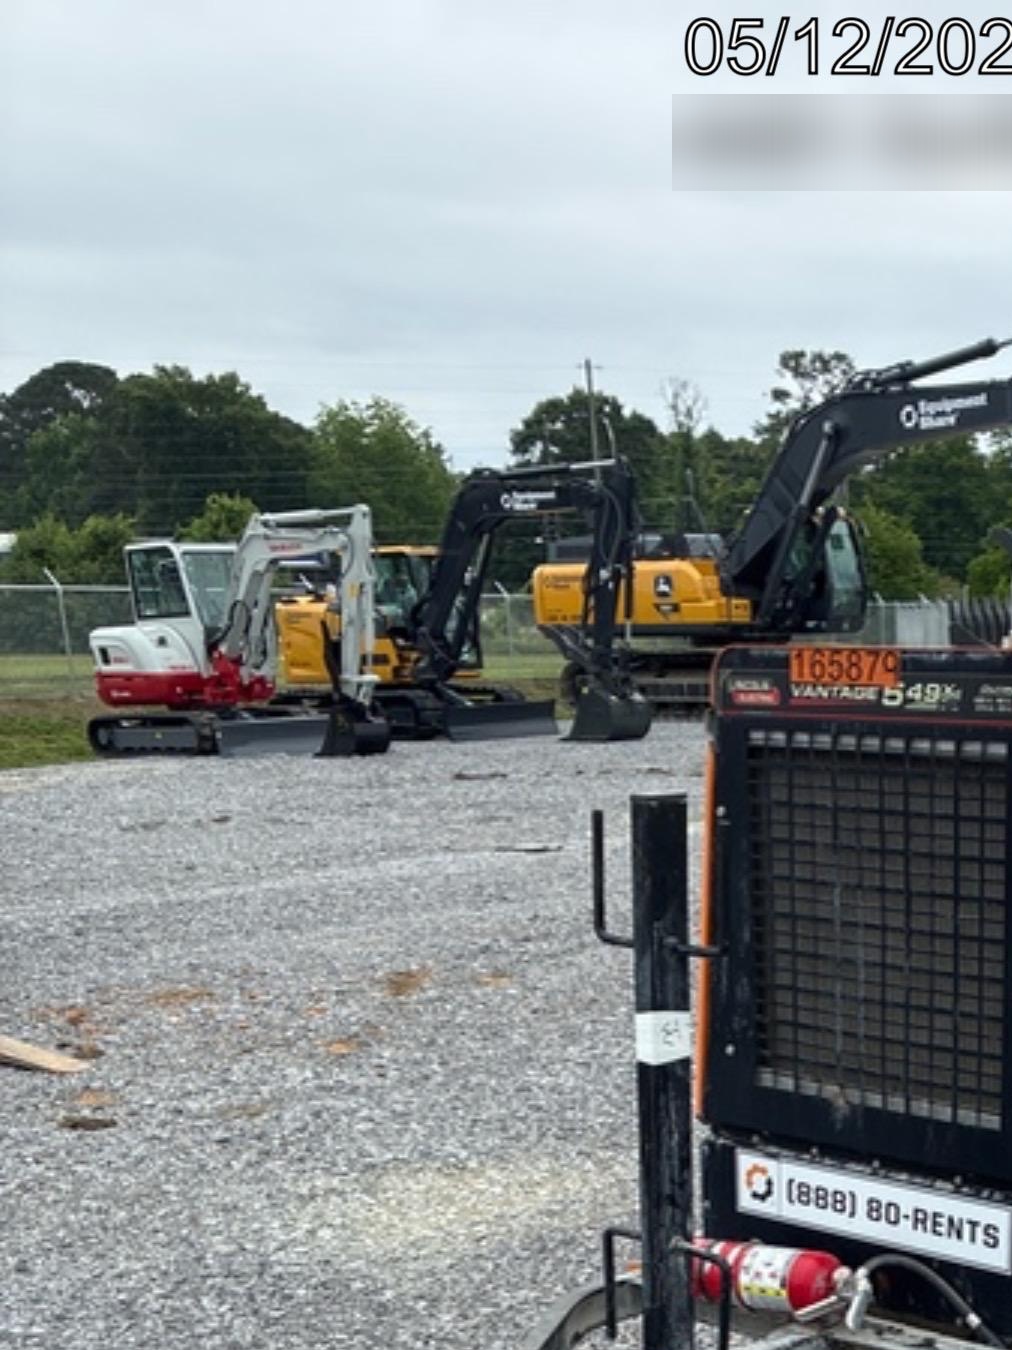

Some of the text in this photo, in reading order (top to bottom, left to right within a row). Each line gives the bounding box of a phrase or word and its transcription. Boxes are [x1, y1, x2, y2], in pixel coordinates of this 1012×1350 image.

[790, 682, 879, 700] VANTAGE
[785, 1177, 1001, 1250] (888) 80-RENTS
